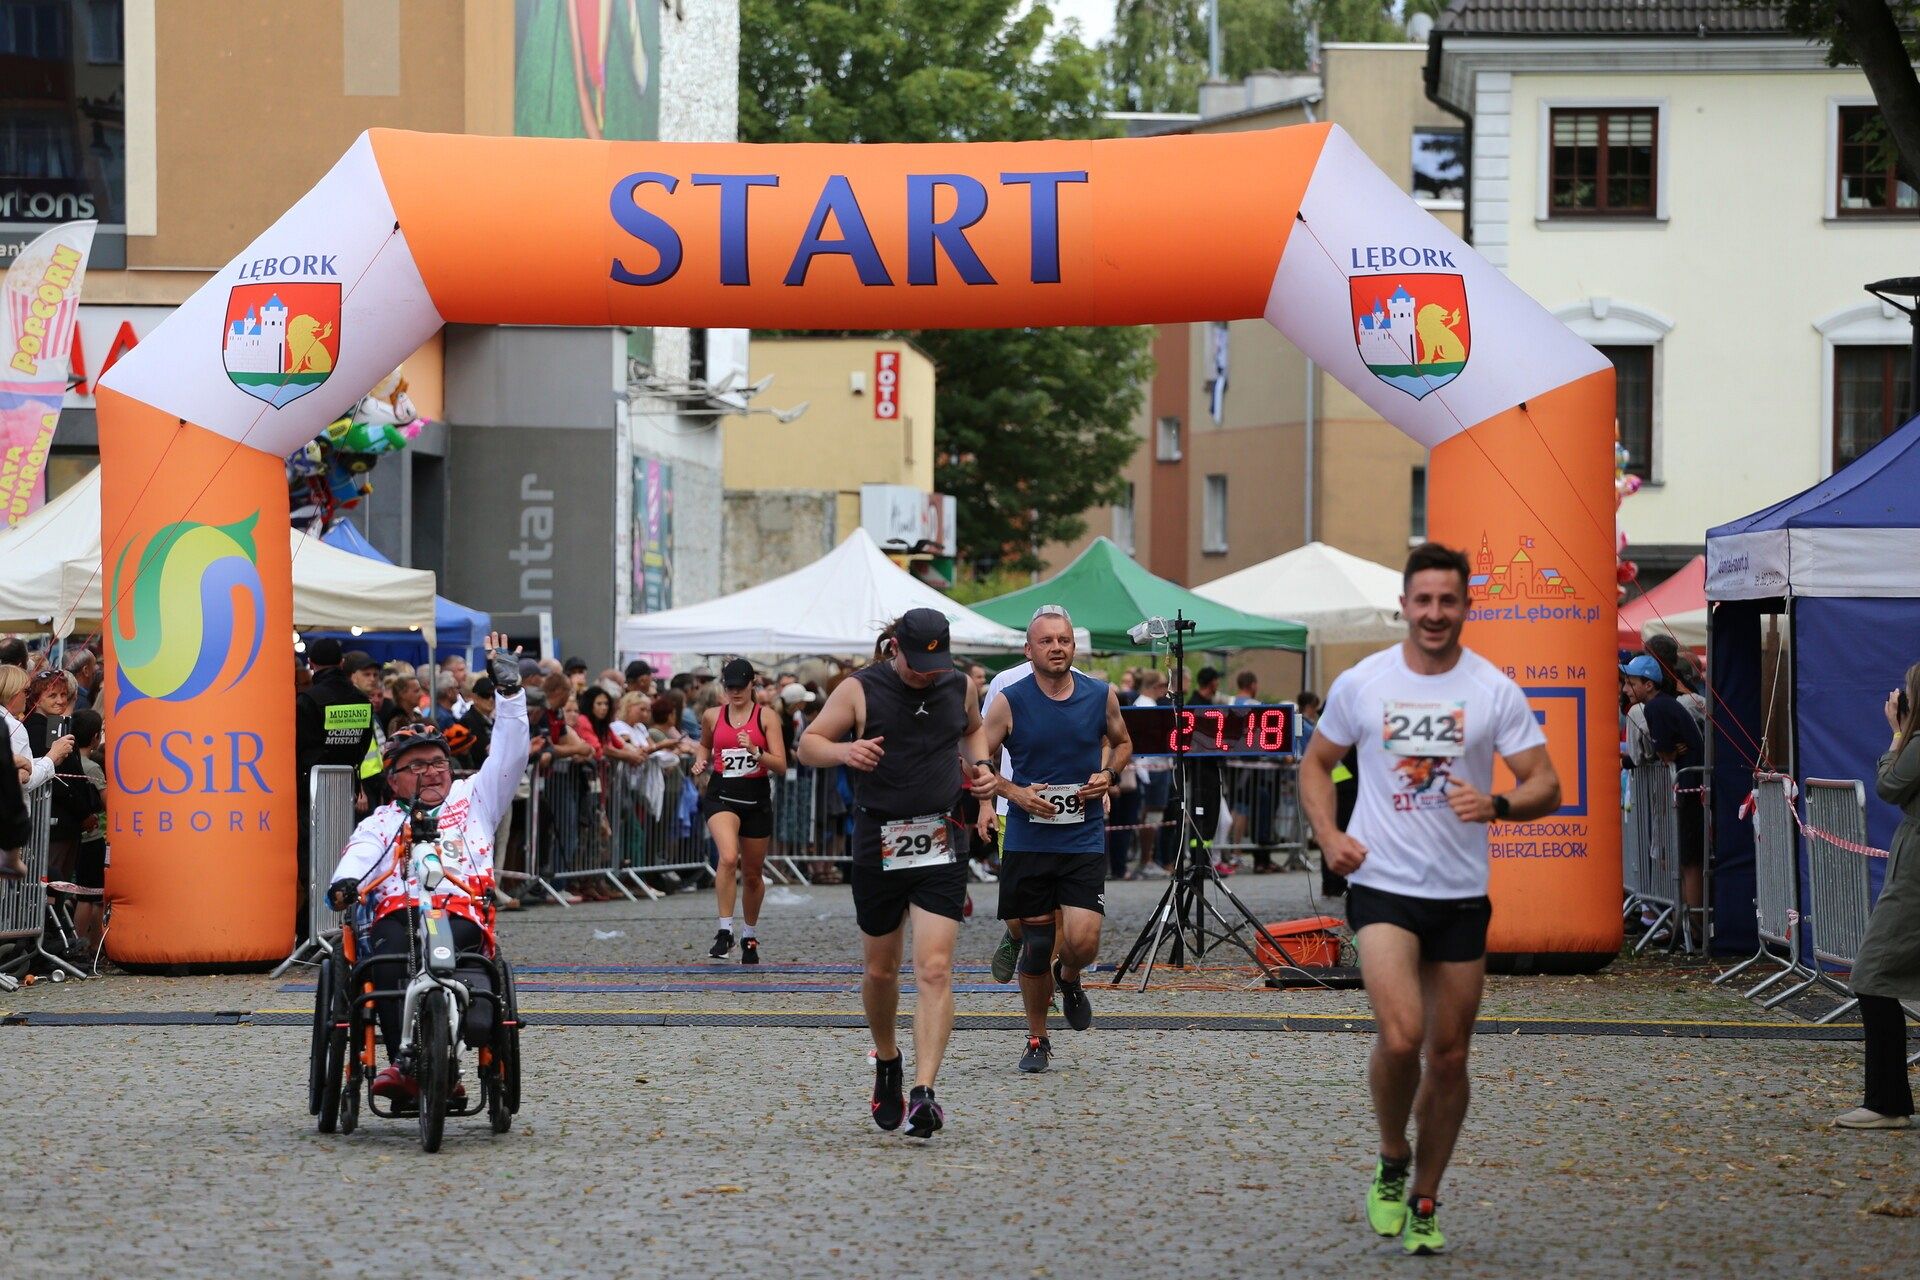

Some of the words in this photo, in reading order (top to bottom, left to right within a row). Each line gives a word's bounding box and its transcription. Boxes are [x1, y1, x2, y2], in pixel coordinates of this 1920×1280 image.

[0, 190, 95, 218] rtons
[609, 171, 1090, 287] START
[239, 255, 337, 280] LĘBORK
[1352, 247, 1456, 271] LĘBORK
[10, 243, 83, 376] POPCORN
[877, 354, 896, 418] FOTO
[508, 473, 554, 615] ntar
[1466, 604, 1600, 623] bierzLębork.pl
[1526, 665, 1558, 679] NAS
[1567, 666, 1586, 679] NA
[1389, 715, 1456, 741] 242
[113, 730, 274, 795] CSiR
[724, 756, 757, 770] 275
[1040, 794, 1080, 815] 69
[115, 811, 271, 836] LĘBORK
[896, 834, 932, 857] 29
[1488, 842, 1588, 858] BIERZLEBORK
